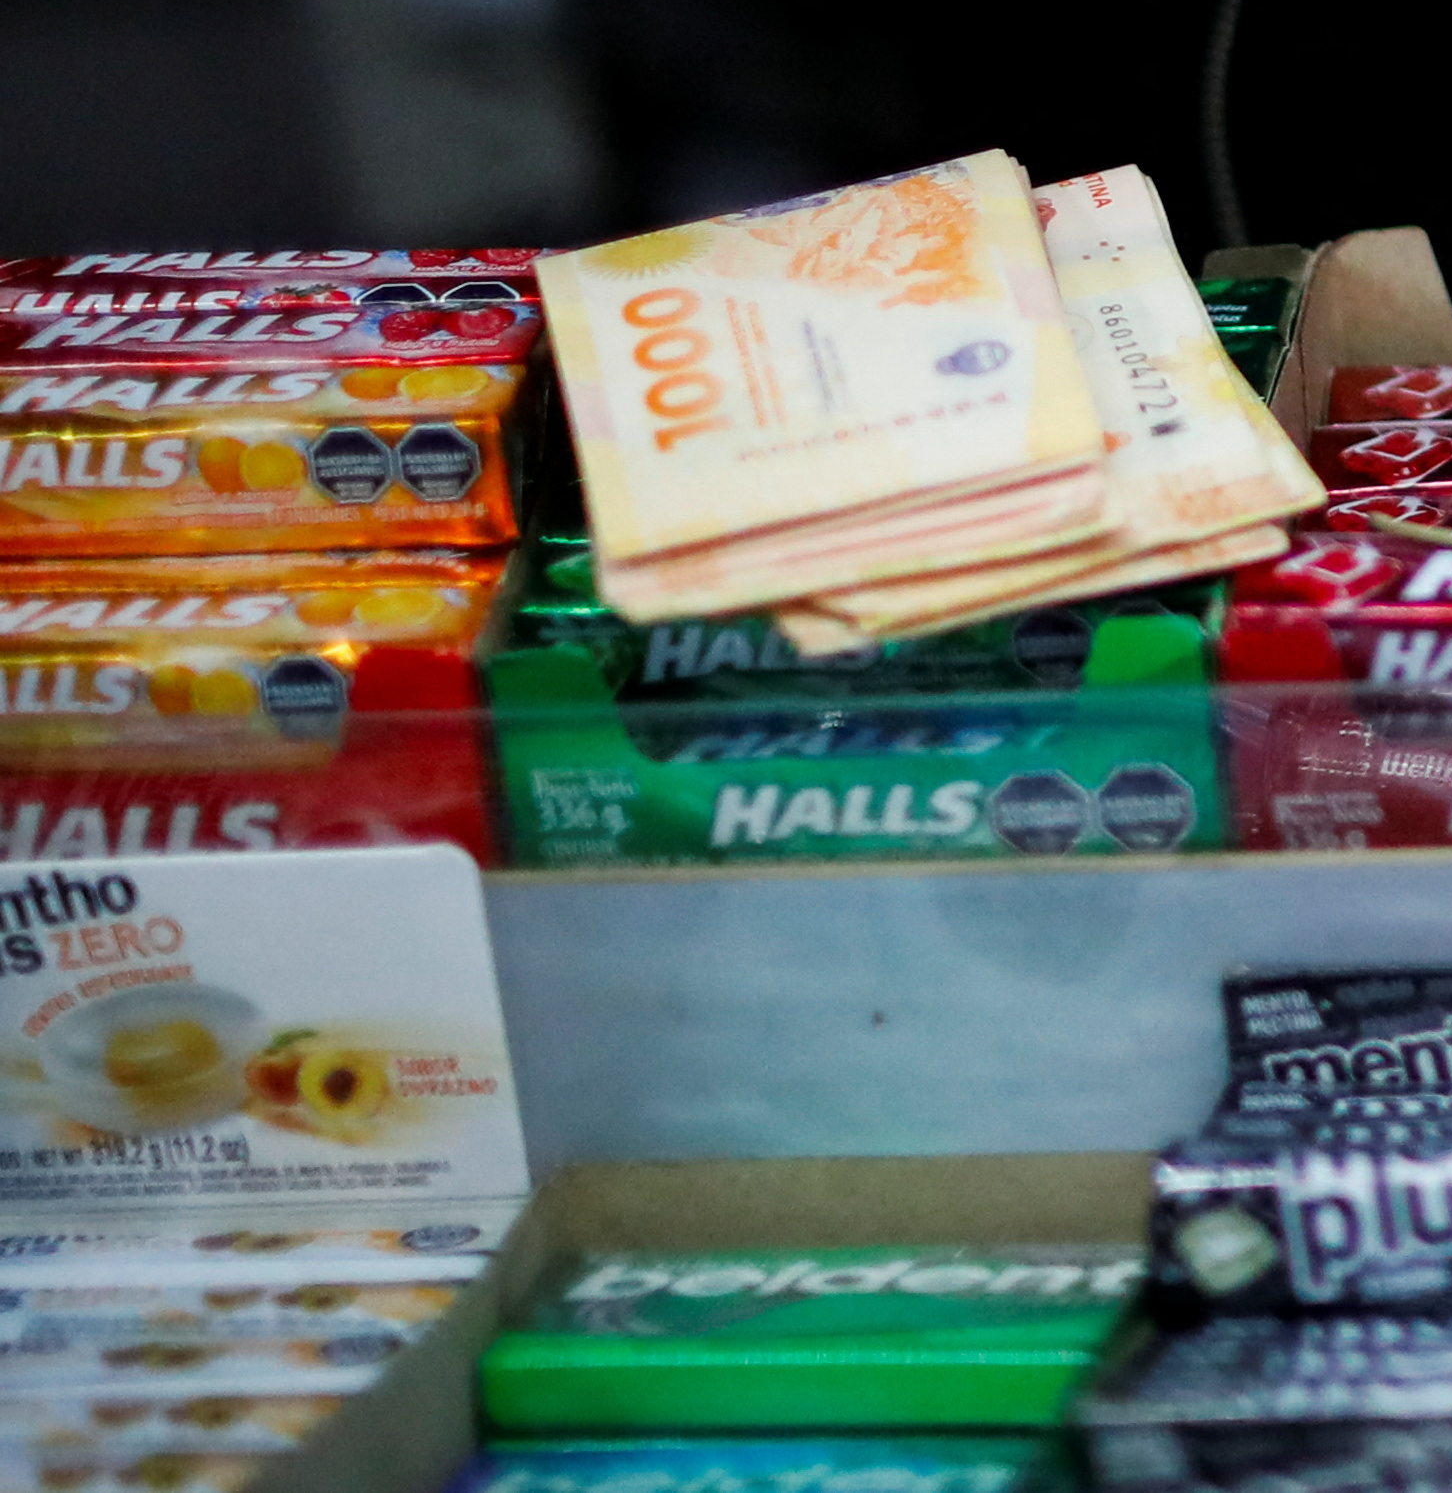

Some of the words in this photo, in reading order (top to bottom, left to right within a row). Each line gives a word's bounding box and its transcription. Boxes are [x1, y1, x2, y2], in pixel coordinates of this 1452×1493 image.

[17, 313, 361, 350] HALLS
[0, 371, 334, 414] HALLS
[620, 287, 734, 453] 1000
[0, 438, 188, 491] ALLS
[710, 779, 986, 846] HALLS
[48, 915, 184, 971] ZERO
